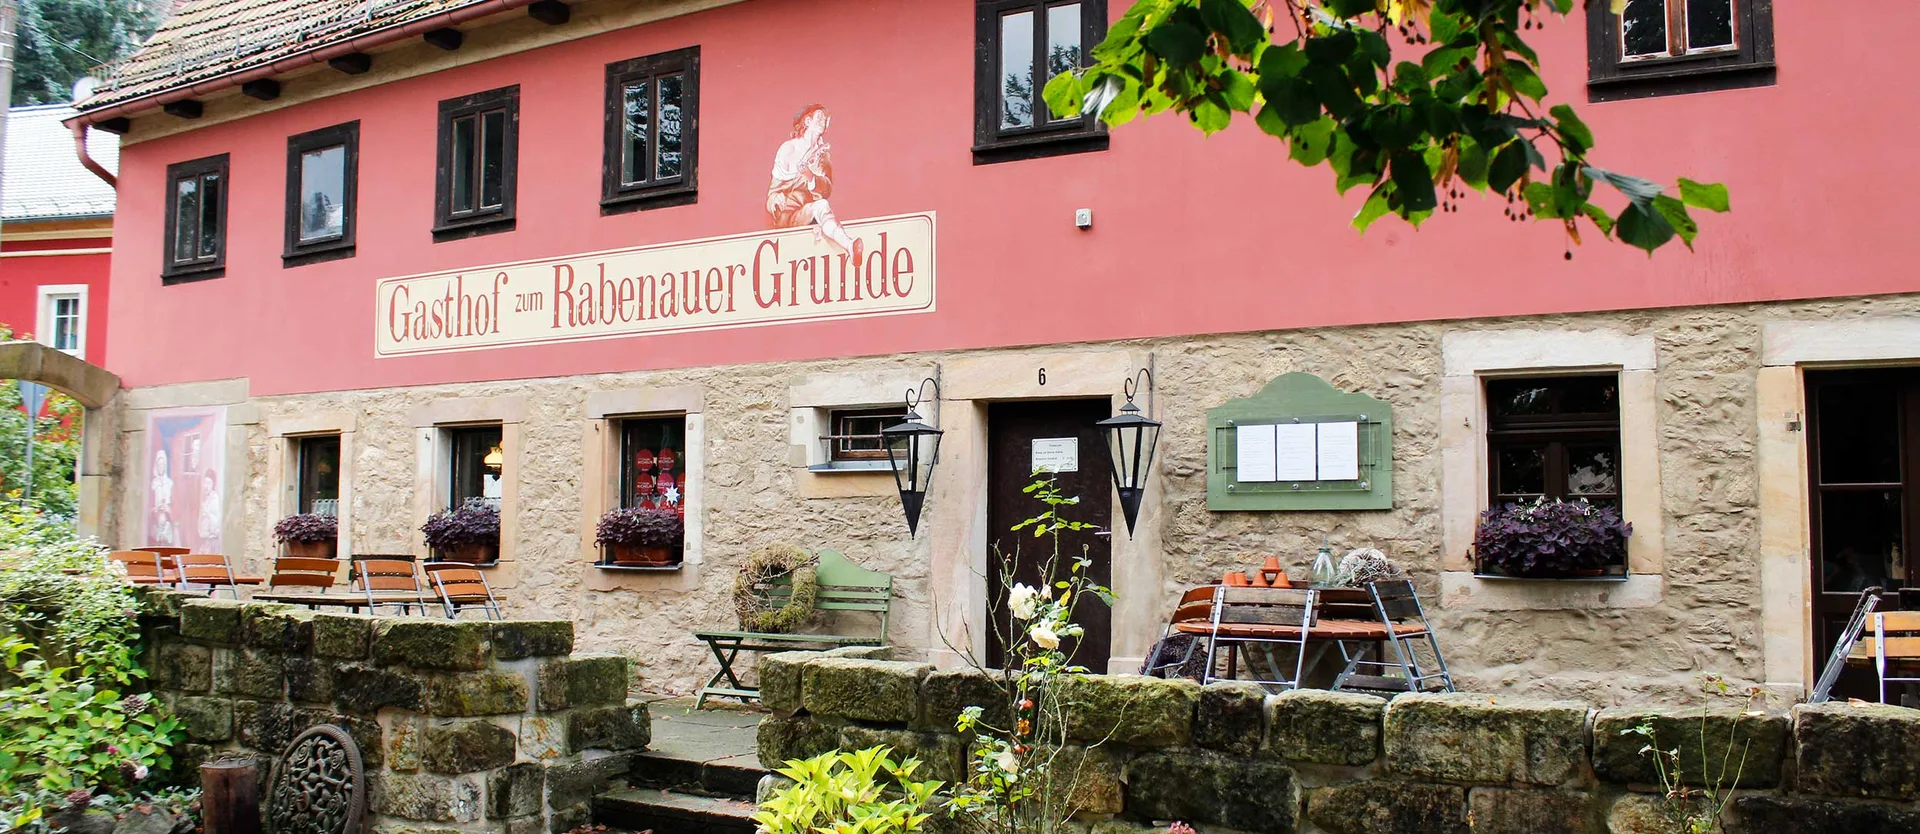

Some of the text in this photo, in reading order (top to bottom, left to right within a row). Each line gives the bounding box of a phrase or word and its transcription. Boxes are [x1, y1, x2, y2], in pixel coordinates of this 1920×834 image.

[388, 231, 914, 344] Gasthof zum Rabenauer Grunde
[1038, 367, 1046, 386] 6
